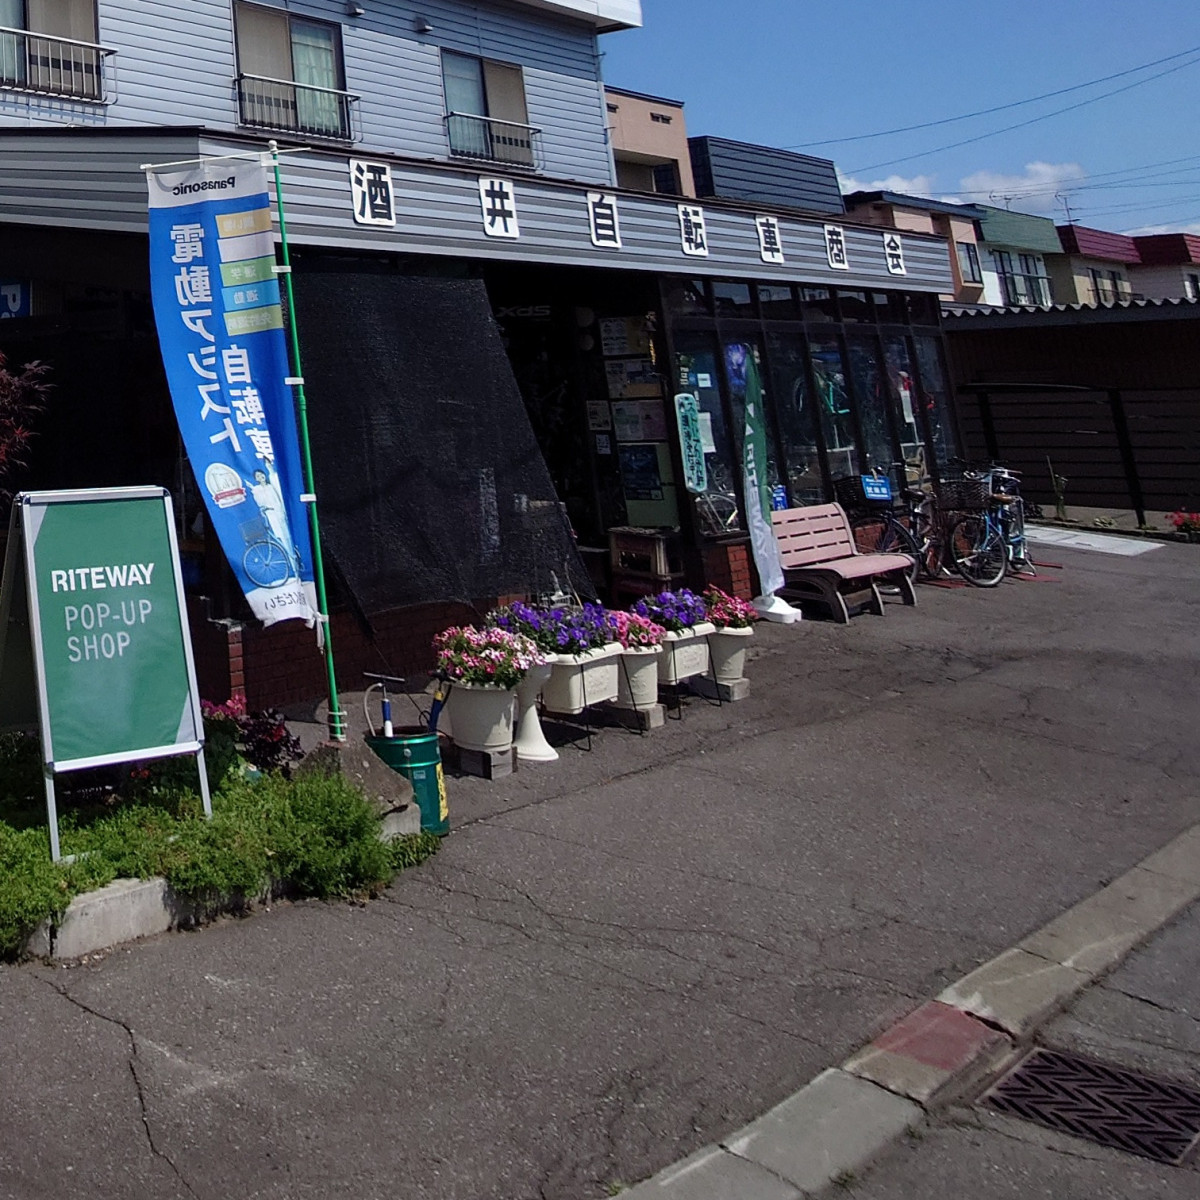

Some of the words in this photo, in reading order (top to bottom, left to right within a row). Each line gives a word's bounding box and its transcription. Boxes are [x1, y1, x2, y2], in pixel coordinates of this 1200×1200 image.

[354, 162, 902, 271] 酒井自転車商会
[51, 563, 154, 592] RITEWAY
[64, 599, 152, 631] POP-UP
[67, 631, 131, 663] SHOP
